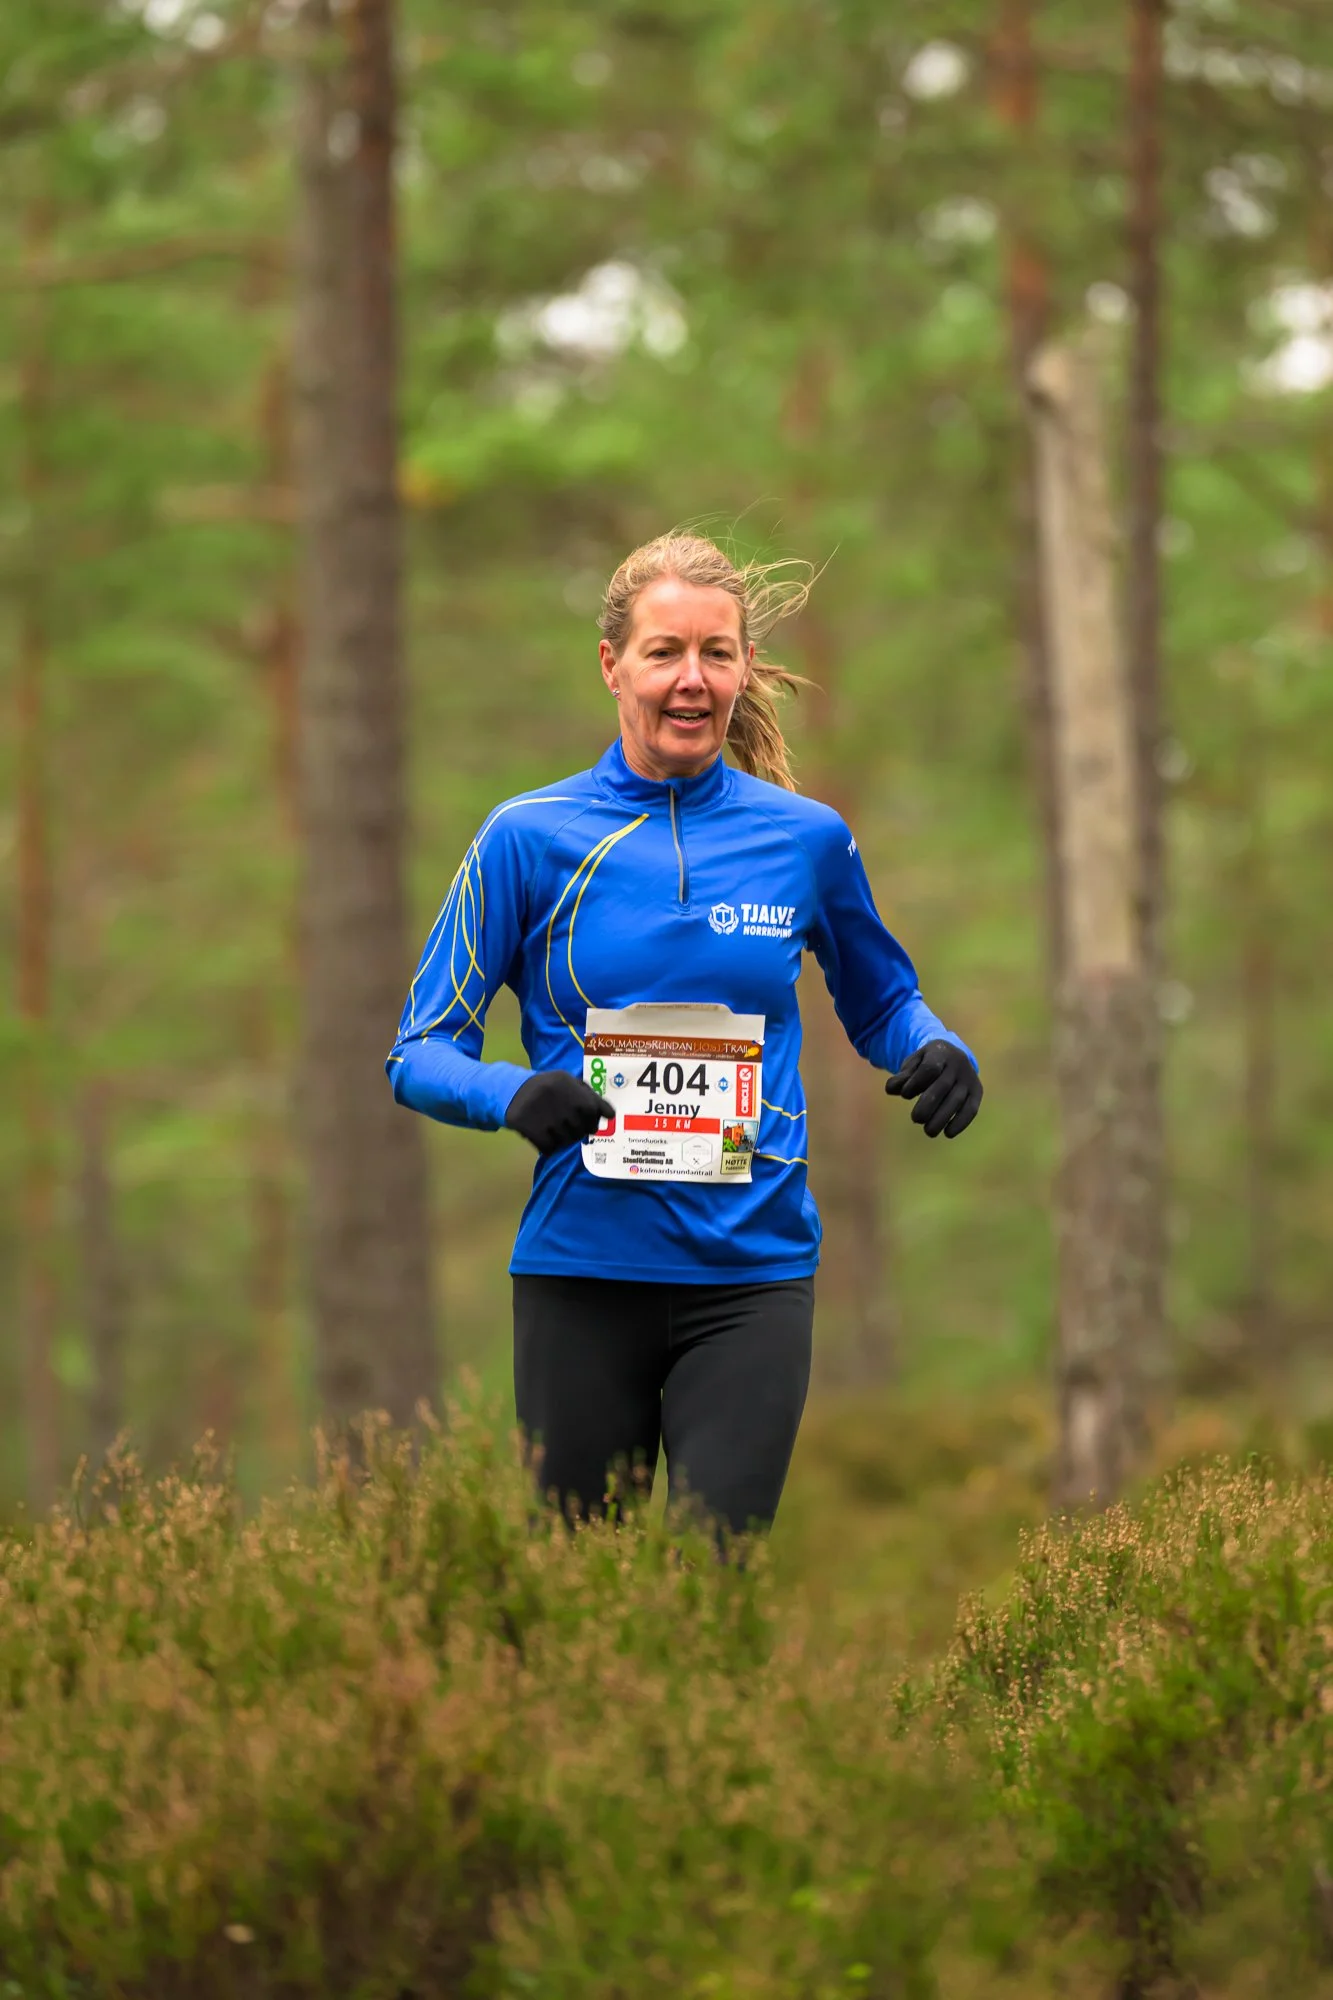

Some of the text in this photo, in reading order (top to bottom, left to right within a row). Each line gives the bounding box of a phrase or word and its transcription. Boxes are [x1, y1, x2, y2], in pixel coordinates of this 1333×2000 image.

[741, 903, 796, 926] TJALVE
[743, 924, 793, 938] NORRKÖPING
[636, 1061, 710, 1096] 404
[741, 1081, 750, 1114] CIRCLE
[645, 1099, 700, 1119] Jenny
[654, 1117, 692, 1130] 15 KM
[639, 1168, 713, 1176] kolmardsrundantrail
